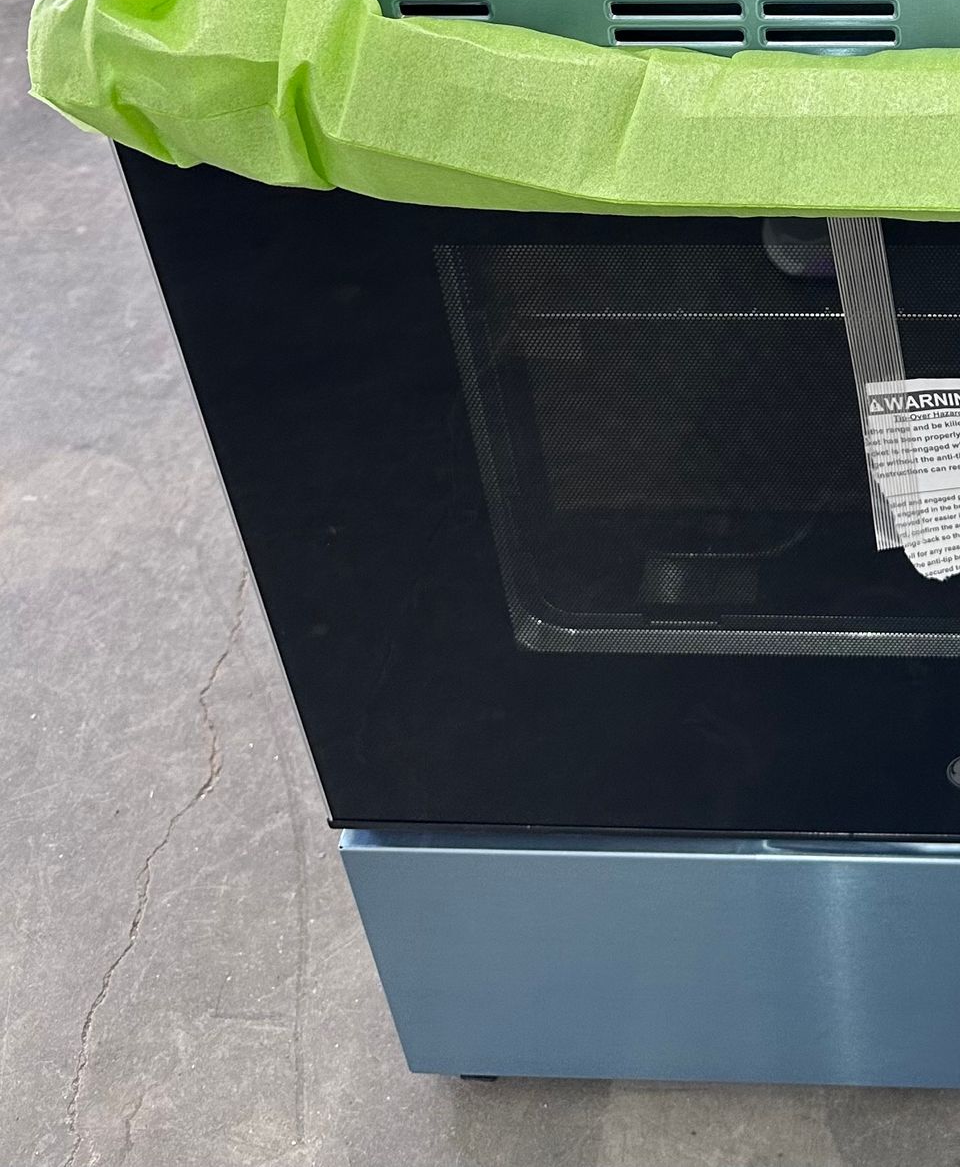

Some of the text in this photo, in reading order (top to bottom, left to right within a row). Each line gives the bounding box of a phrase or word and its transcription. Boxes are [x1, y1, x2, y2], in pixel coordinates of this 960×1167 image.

[913, 424, 930, 432] and
[925, 432, 960, 442] properly
[902, 443, 950, 454] re-engaged
[921, 455, 935, 463] the
[931, 505, 938, 513] in
[922, 516, 932, 524] for
[935, 514, 957, 522] easier
[941, 523, 953, 531] the
[917, 550, 927, 558] for
[927, 556, 953, 566] anti-tip
